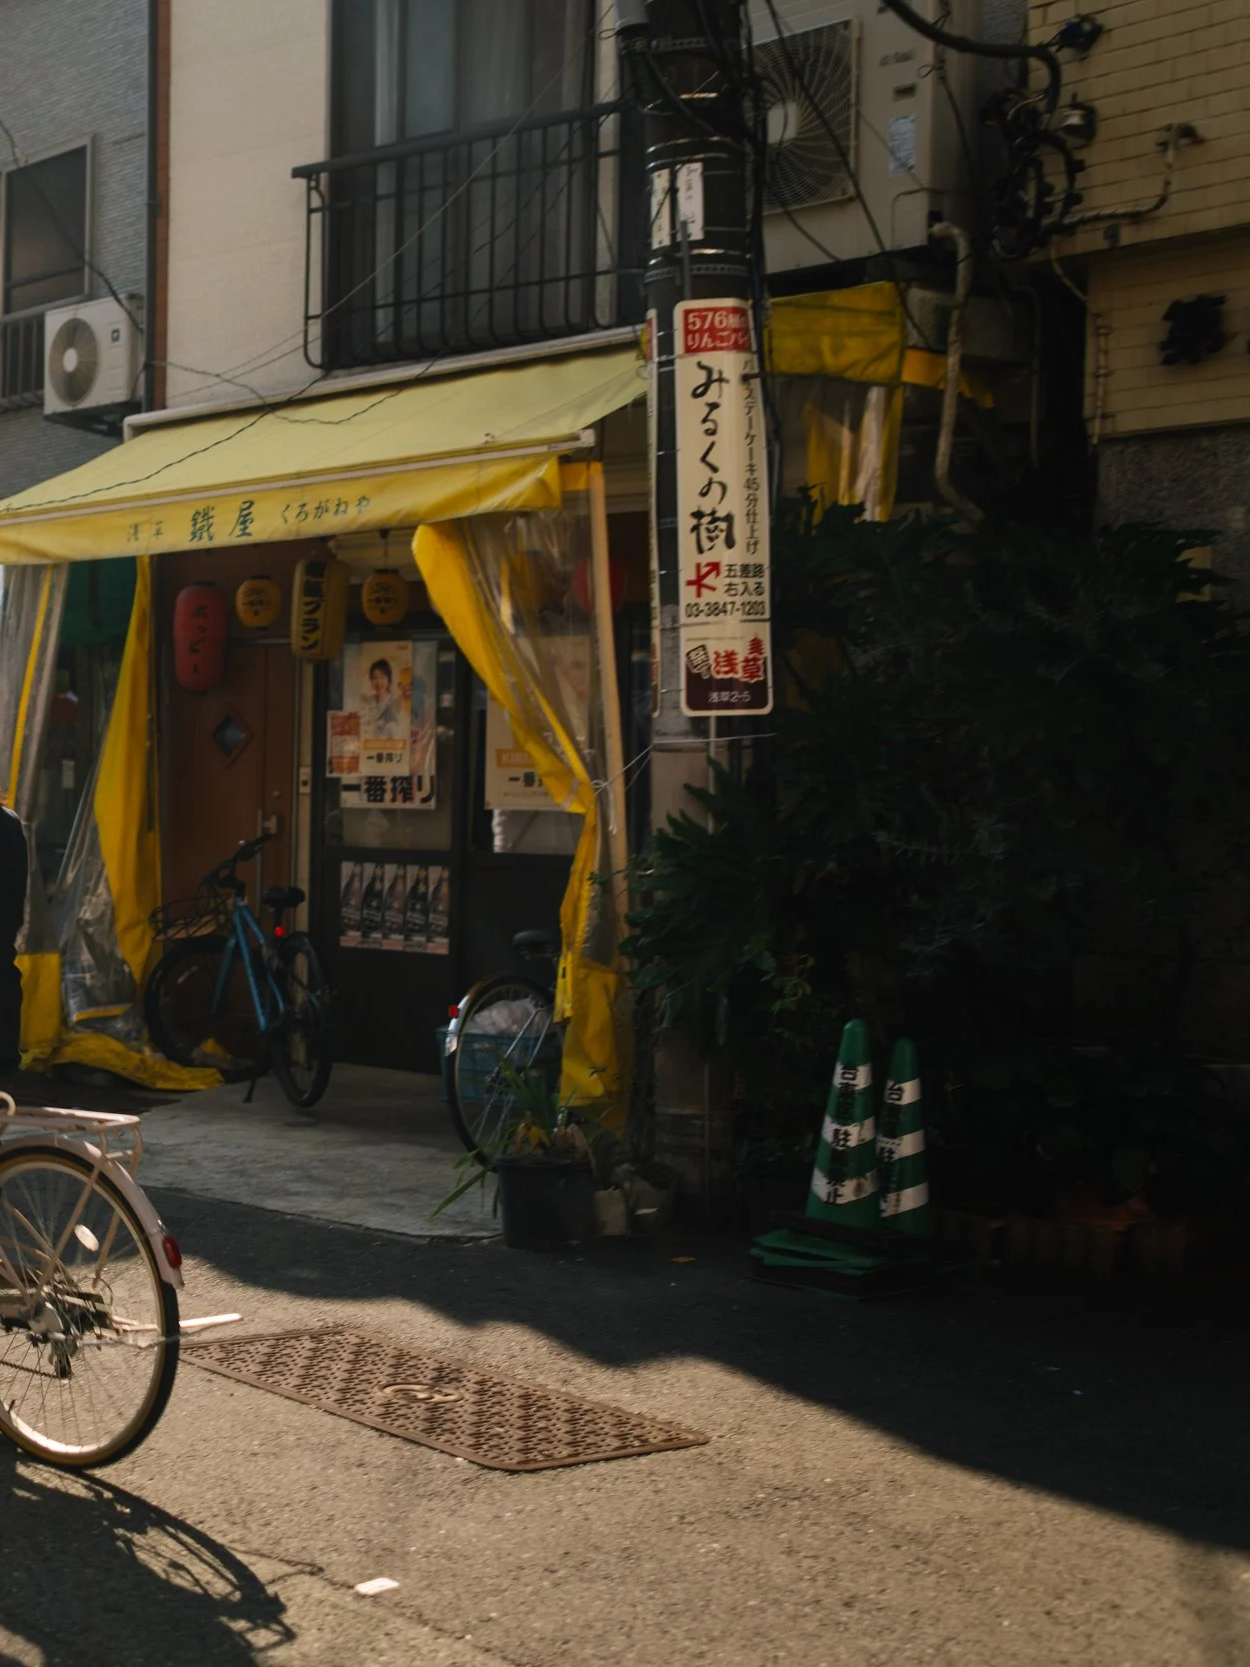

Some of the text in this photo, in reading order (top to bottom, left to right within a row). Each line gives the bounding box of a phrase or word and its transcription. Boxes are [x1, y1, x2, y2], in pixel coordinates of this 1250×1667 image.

[280, 495, 371, 525] くろがねや
[723, 581, 765, 597] 右入る
[341, 774, 436, 804] 一番搾り
